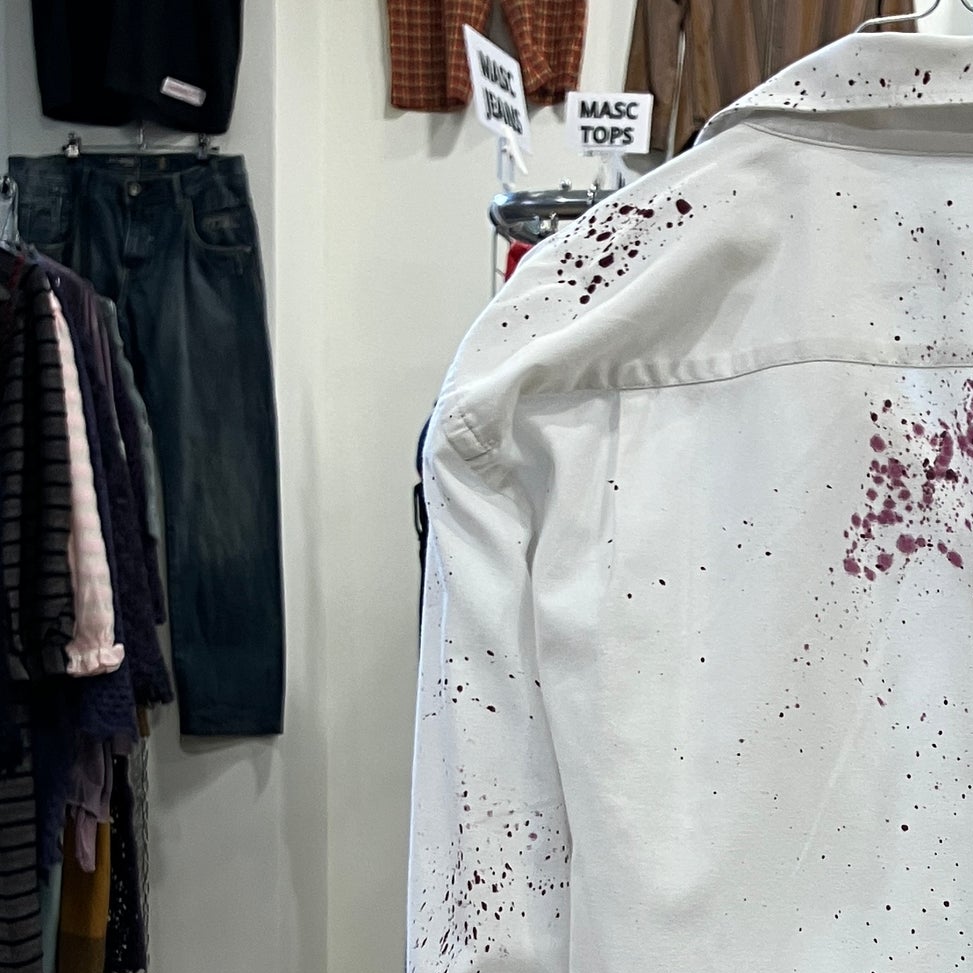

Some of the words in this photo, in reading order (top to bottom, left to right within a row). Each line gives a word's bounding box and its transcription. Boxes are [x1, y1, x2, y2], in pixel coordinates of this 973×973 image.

[478, 51, 517, 97] MASC
[483, 87, 524, 135] JEANS
[580, 100, 639, 120] MASC
[580, 126, 635, 145] TOPS
